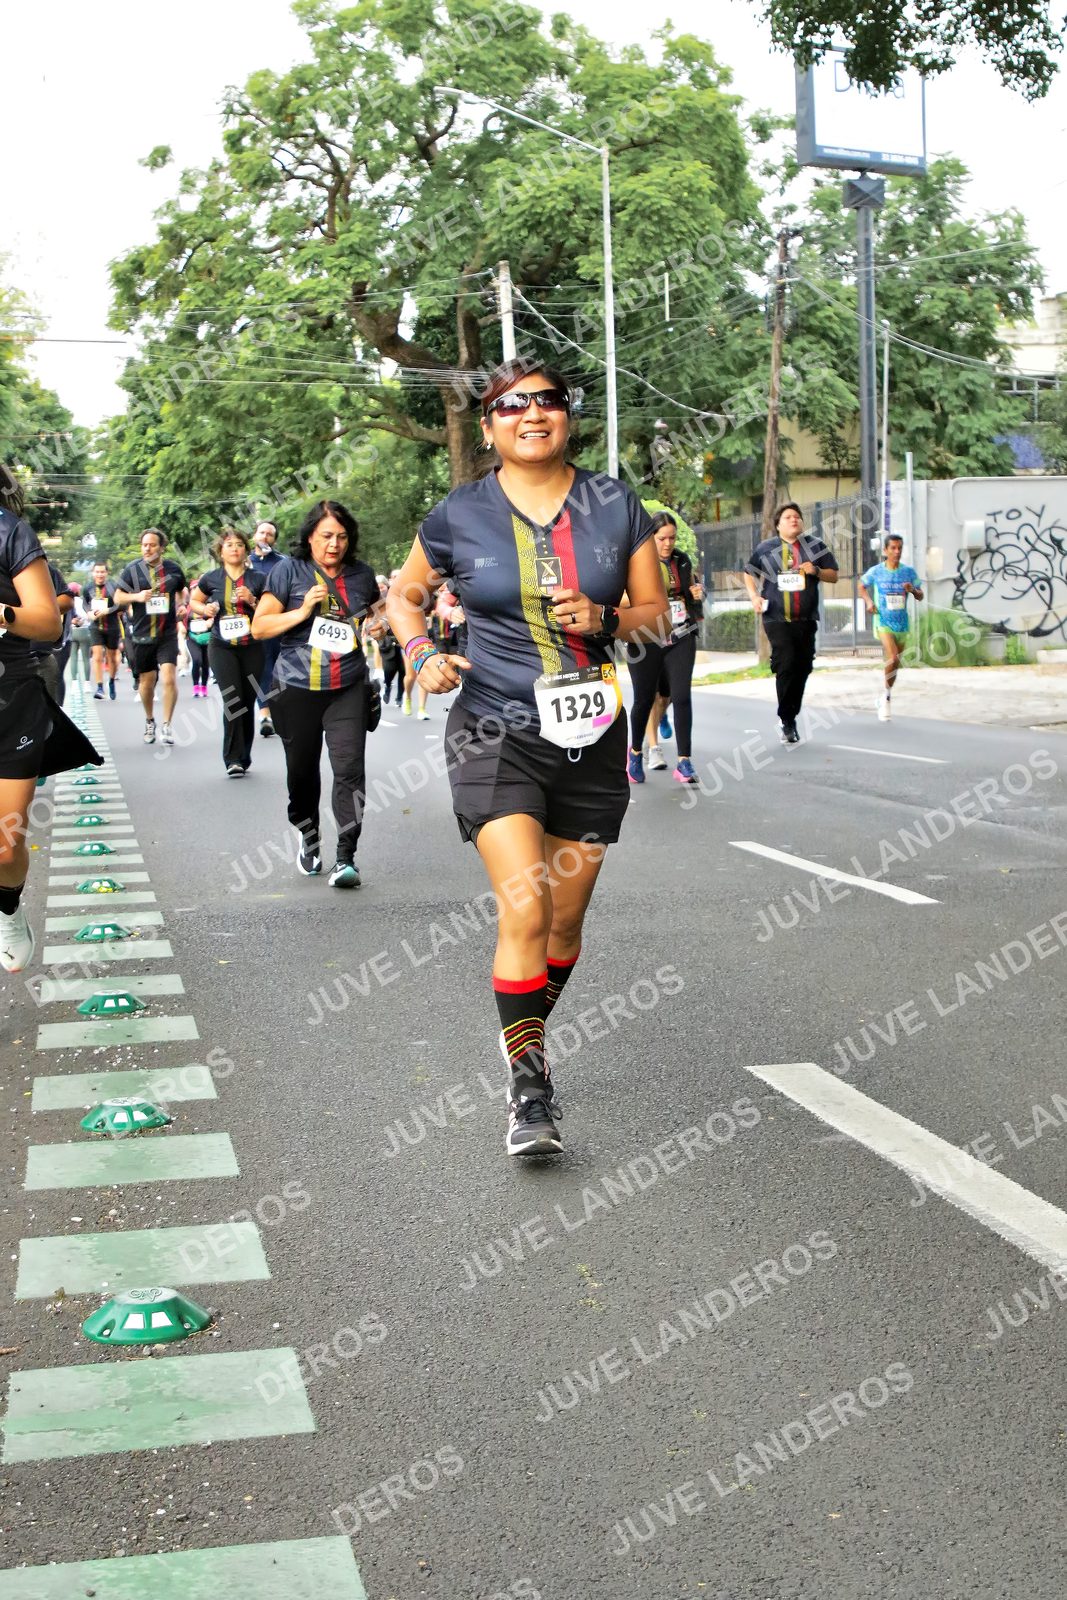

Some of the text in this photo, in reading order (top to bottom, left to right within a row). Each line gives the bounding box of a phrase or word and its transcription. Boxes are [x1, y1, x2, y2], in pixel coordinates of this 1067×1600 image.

[986, 504, 1045, 528] TOY
[224, 620, 244, 631] 2283
[318, 623, 348, 641] 6493
[550, 690, 606, 724] 1329
